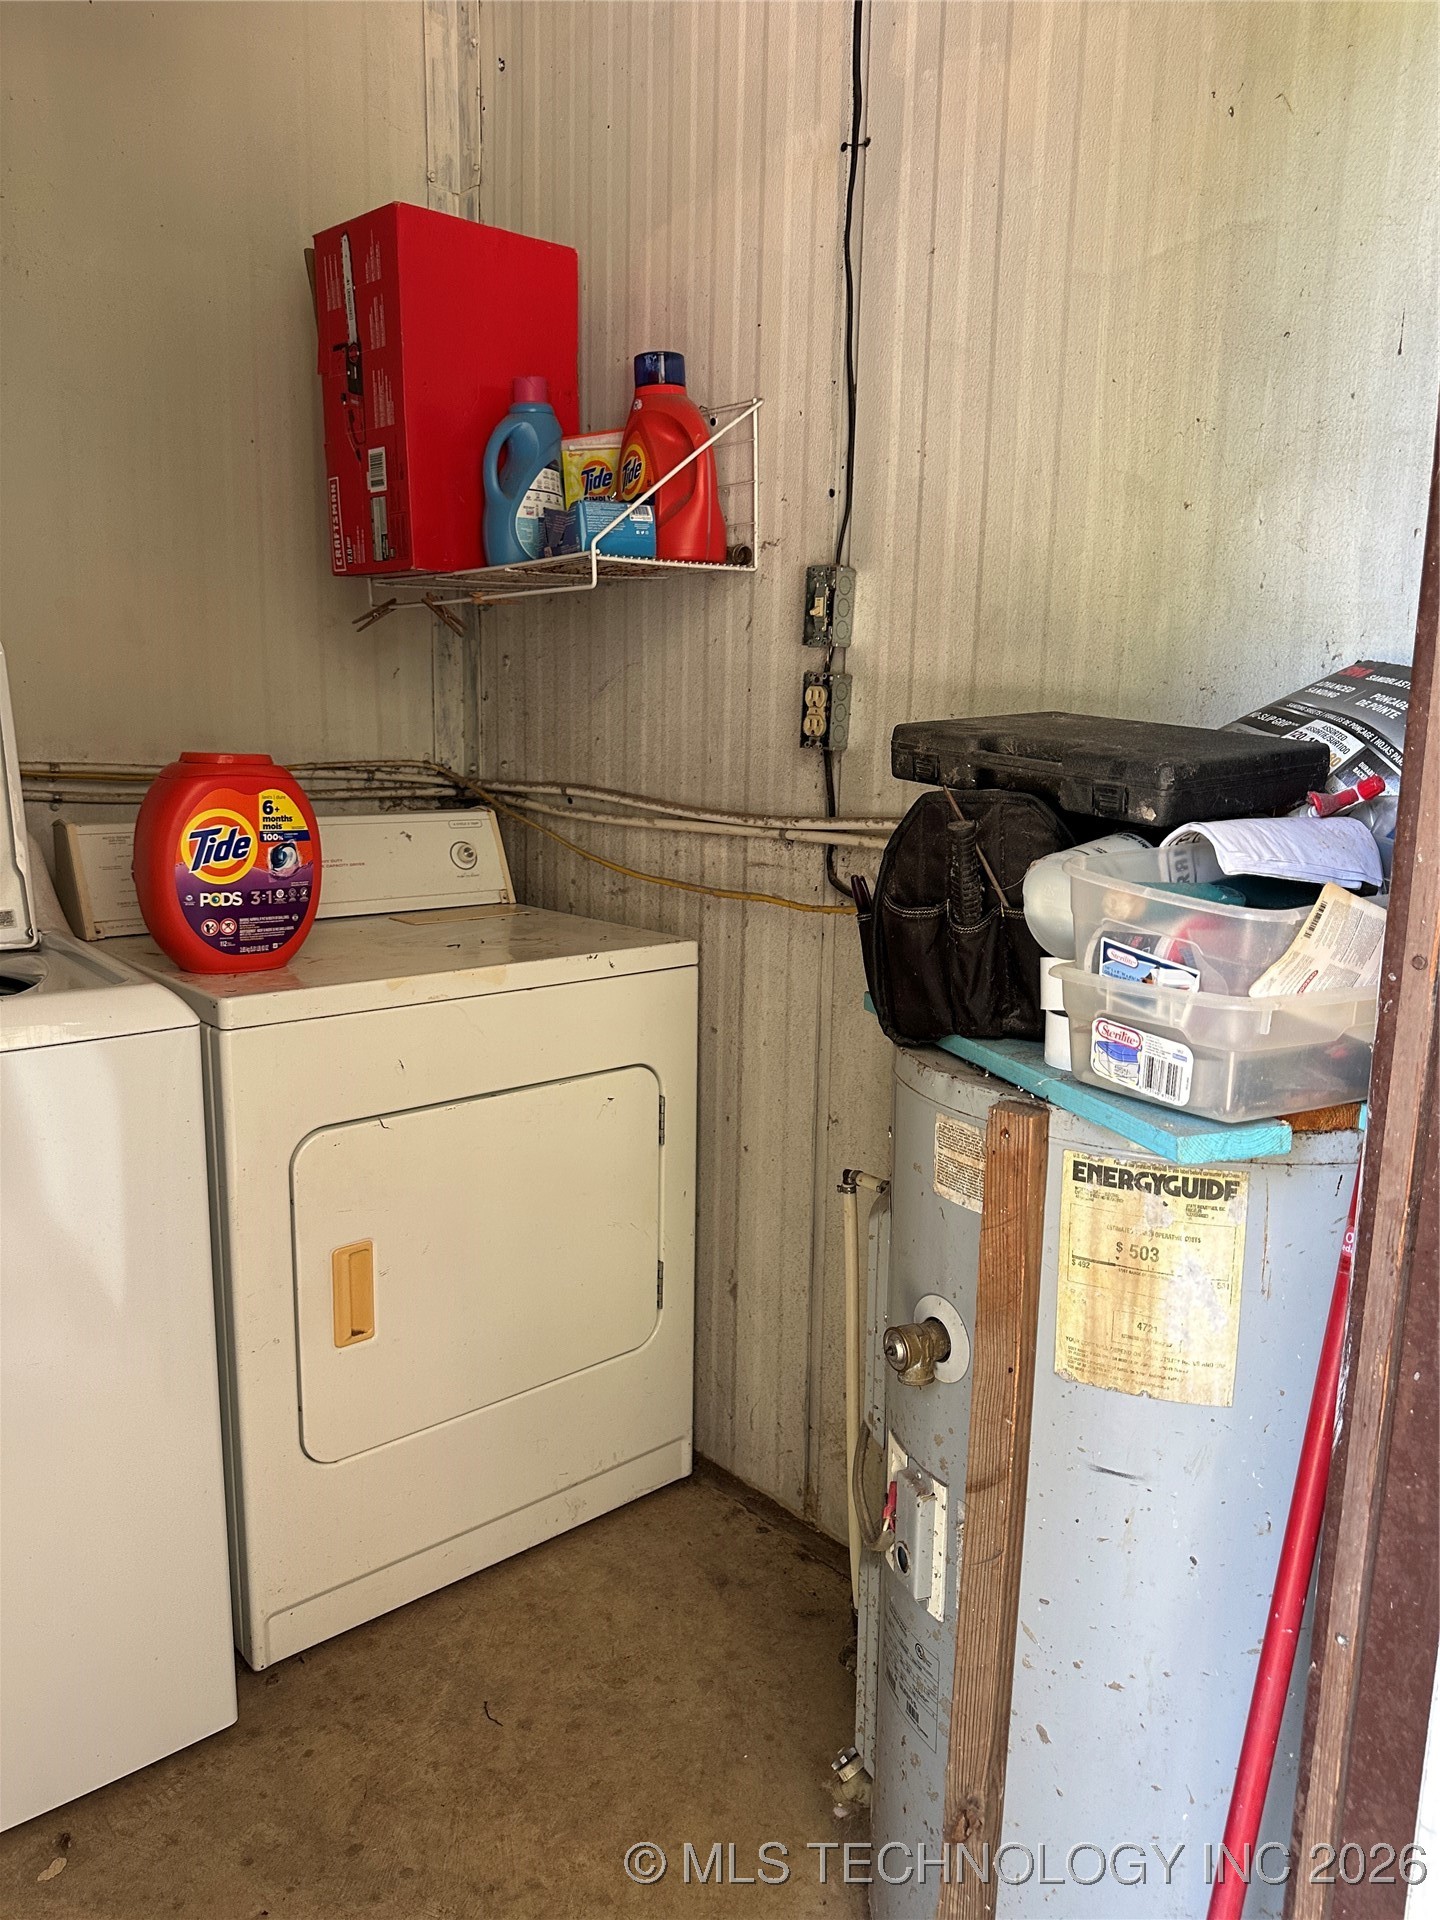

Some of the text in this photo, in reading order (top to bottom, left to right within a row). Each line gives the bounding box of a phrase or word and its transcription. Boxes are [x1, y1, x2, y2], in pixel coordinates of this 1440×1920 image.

[581, 467, 613, 495] Tide
[622, 456, 642, 493] Tide
[331, 484, 342, 566] CRAFTSMAN
[1355, 699, 1402, 719] DE POINTE
[1374, 738, 1394, 756] HOJAS
[262, 822, 283, 830] mois
[189, 826, 251, 874] Tide
[200, 892, 242, 907] PODS
[1102, 1024, 1138, 1045] Sterilite
[1072, 1160, 1240, 1201] ENERGYGUIDE
[1129, 1244, 1160, 1262] 503
[1078, 1260, 1091, 1269] 492
